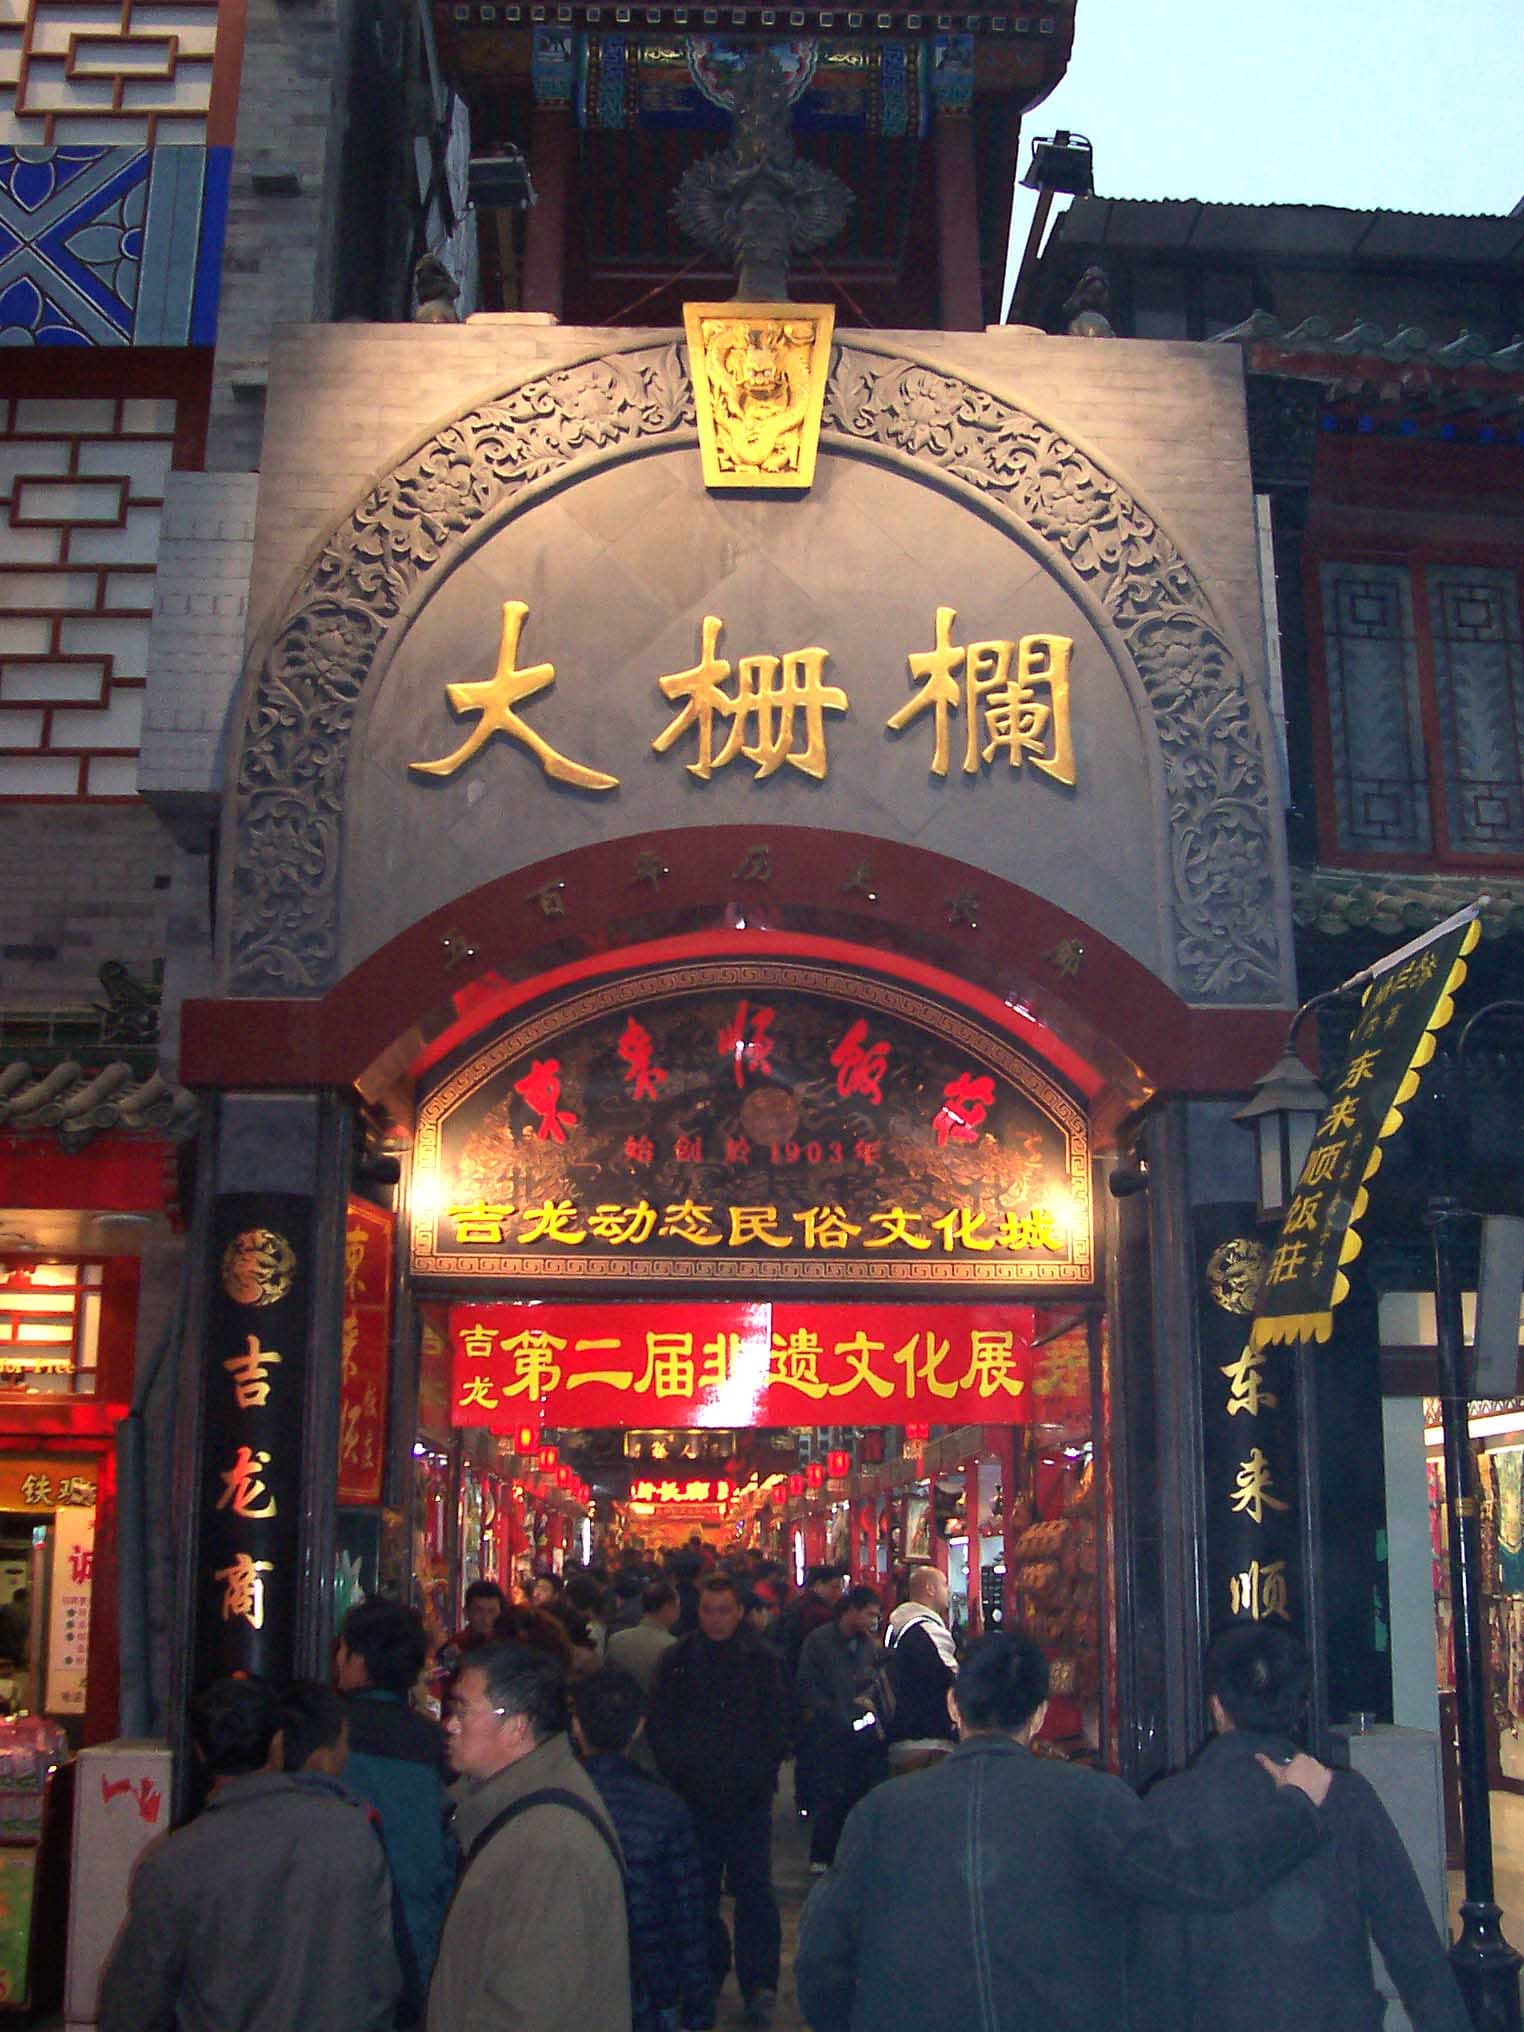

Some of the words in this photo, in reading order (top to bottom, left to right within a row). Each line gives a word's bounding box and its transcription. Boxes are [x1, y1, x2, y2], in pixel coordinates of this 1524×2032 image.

[450, 1198, 1064, 1251] 吉龙动态民俗文化城
[458, 1322, 500, 1412] 吉龙
[215, 1334, 283, 1630] 吉龙商
[1219, 1346, 1292, 1622] 东来顺
